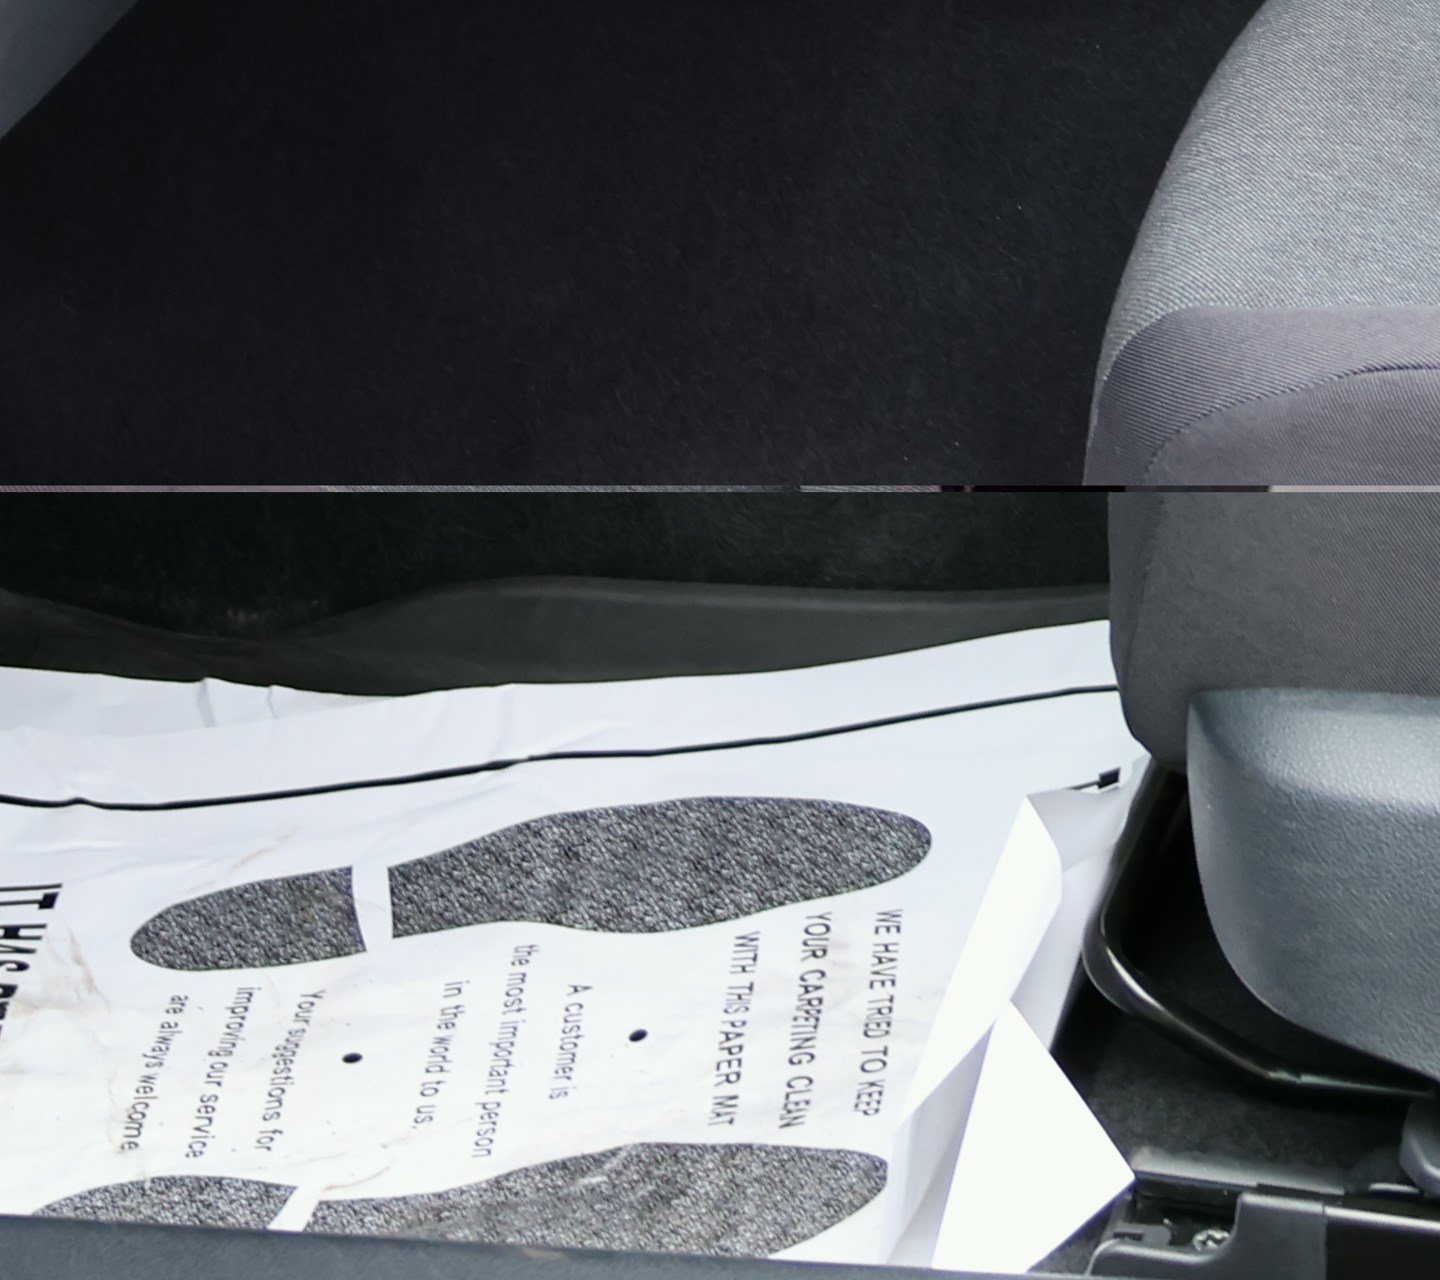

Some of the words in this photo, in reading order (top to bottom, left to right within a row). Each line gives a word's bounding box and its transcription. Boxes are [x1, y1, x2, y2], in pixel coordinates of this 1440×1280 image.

[800, 911, 832, 962] YOUR
[874, 908, 903, 935] WE
[510, 944, 540, 966] the
[729, 931, 760, 974] WITH
[869, 942, 900, 990] HAVE
[164, 994, 189, 1015] are
[442, 979, 471, 998] in
[502, 972, 527, 1015] most
[566, 983, 593, 996] A
[722, 981, 754, 1015] THIS
[207, 986, 262, 1057] improving
[292, 990, 326, 1027] Your
[437, 1004, 466, 1030] the
[787, 969, 827, 1066] CARPETING
[863, 994, 895, 1039] TRIED
[142, 1020, 183, 1069] always
[424, 1035, 454, 1074] world
[485, 1019, 527, 1096] important
[553, 1002, 585, 1082] customer
[713, 1020, 748, 1087] PAPER
[860, 1045, 889, 1074] TO
[204, 1061, 229, 1087] our
[262, 1028, 306, 1122] suggestions
[419, 1079, 446, 1098] to
[548, 1086, 577, 1100] is
[120, 1071, 159, 1151] welcome
[707, 1093, 739, 1127] MAT
[778, 1075, 814, 1129] CLEAN
[854, 1078, 886, 1116] KEEP
[185, 1093, 219, 1159] service
[411, 1104, 436, 1130] us.
[471, 1100, 502, 1158] person
[254, 1128, 284, 1151] for
